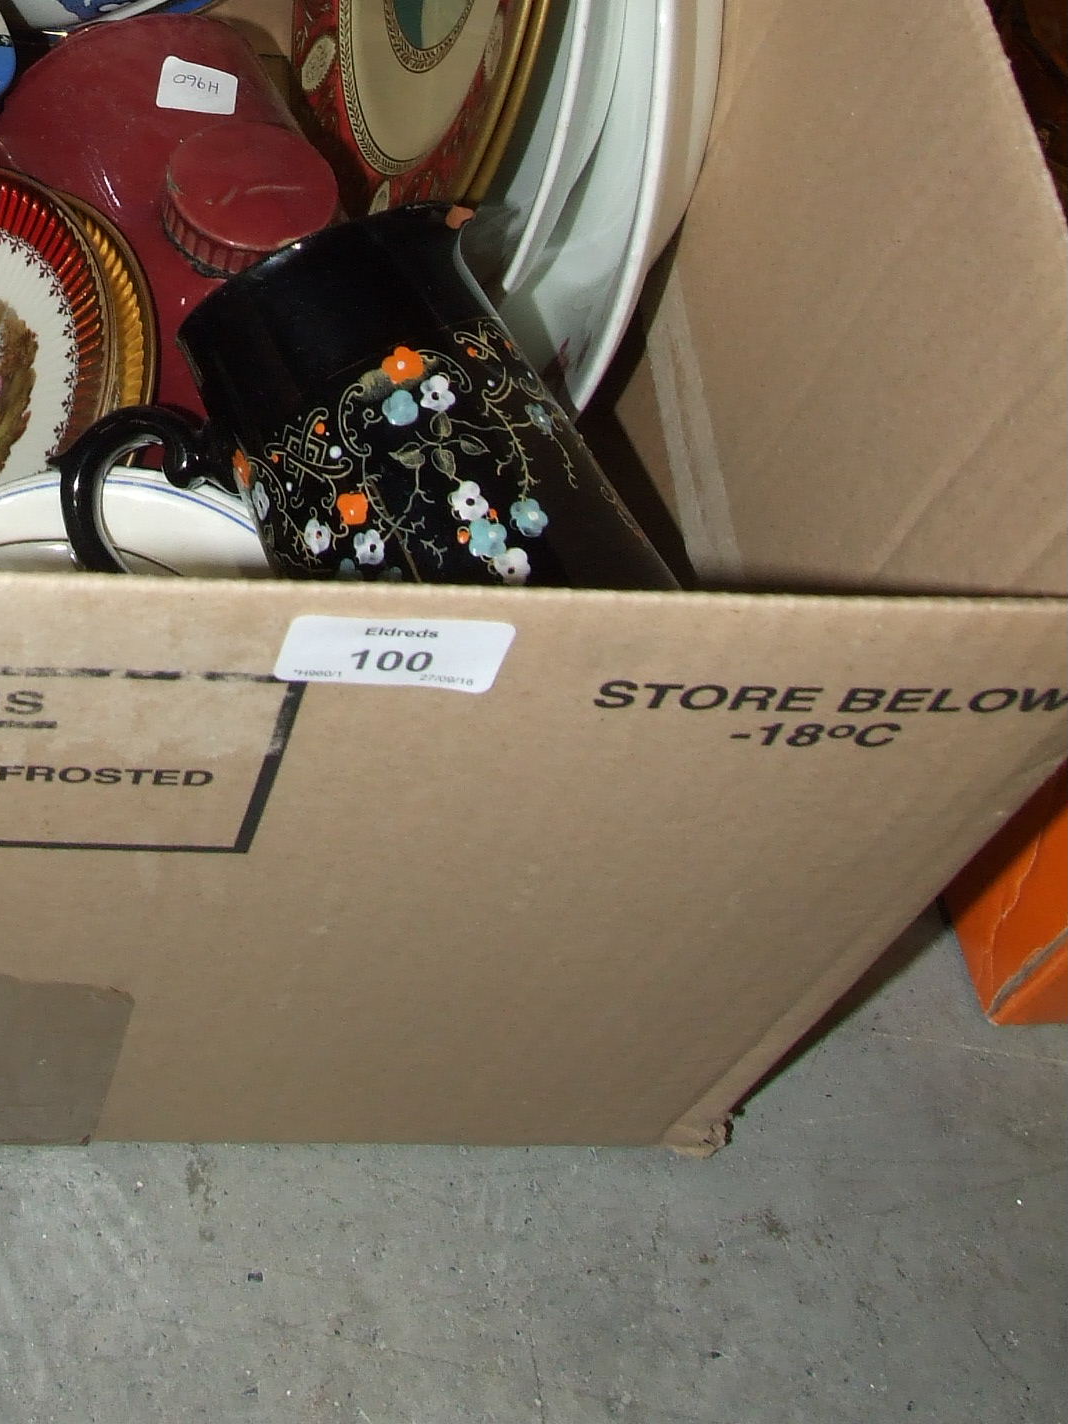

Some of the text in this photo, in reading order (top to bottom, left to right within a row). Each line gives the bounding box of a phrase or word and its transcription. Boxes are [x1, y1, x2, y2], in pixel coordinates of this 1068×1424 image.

[365, 627, 438, 638] Eldreds
[351, 649, 433, 672] 100
[593, 679, 1068, 713] STORE BELOW
